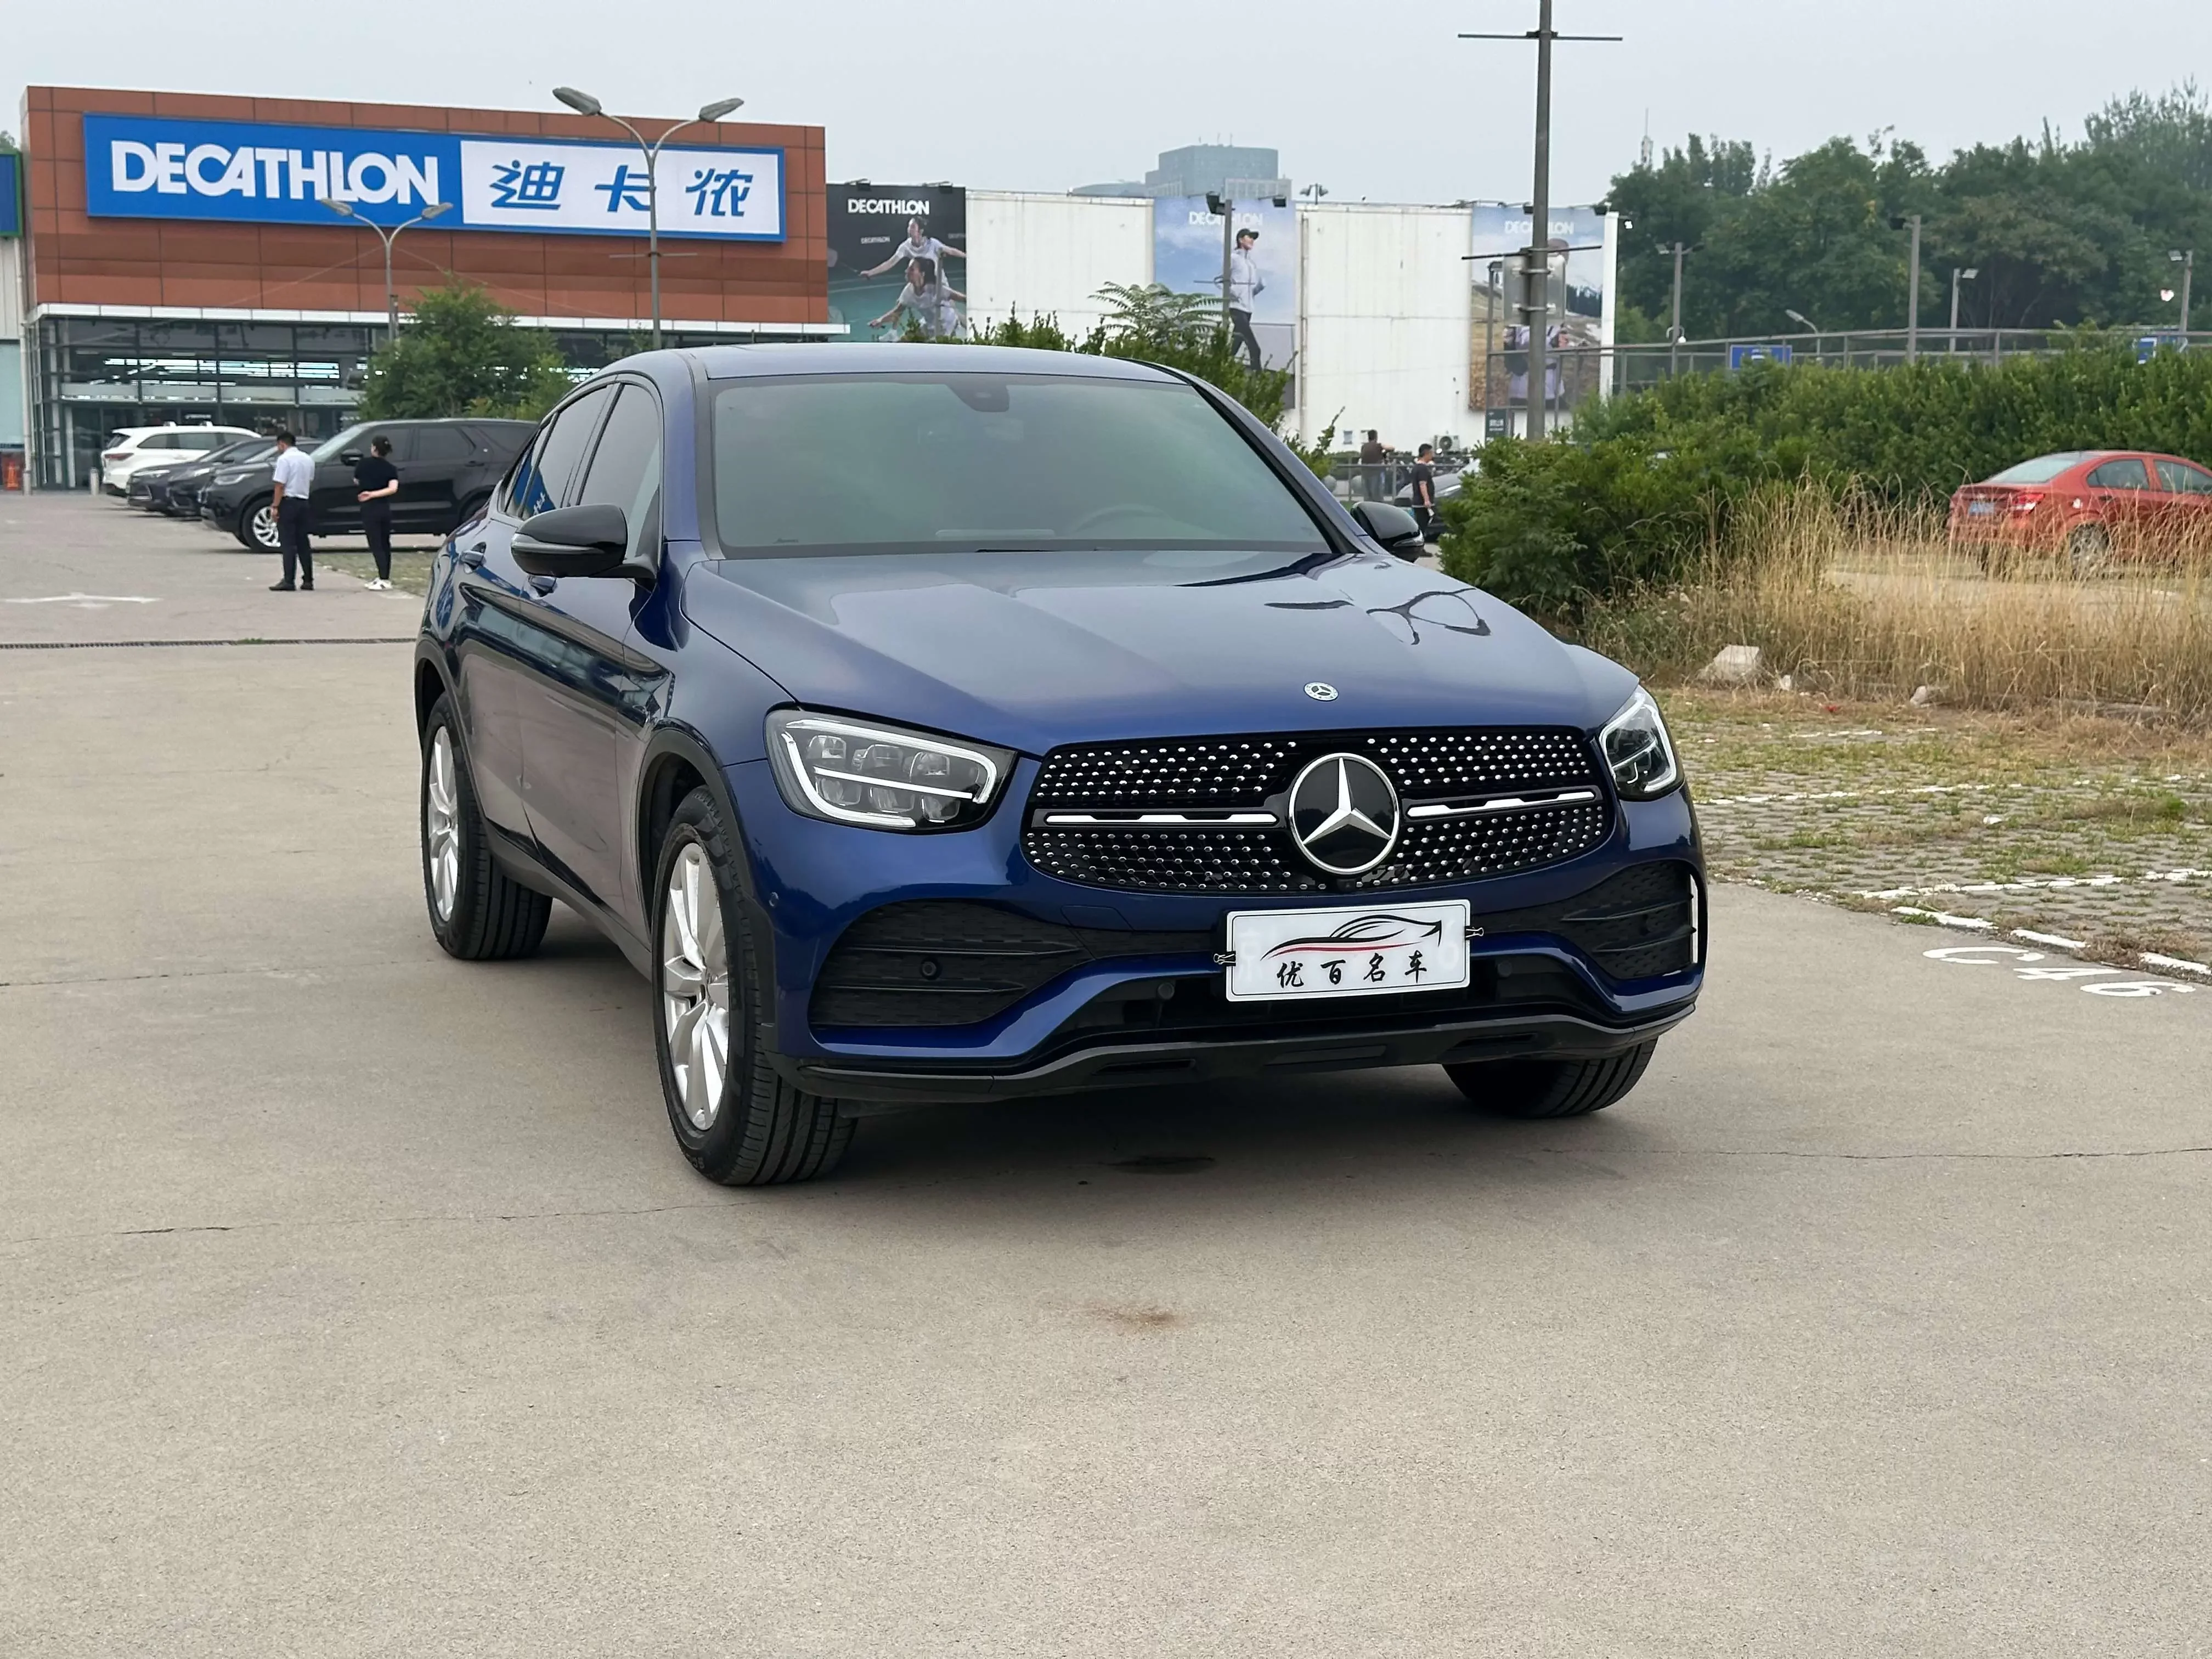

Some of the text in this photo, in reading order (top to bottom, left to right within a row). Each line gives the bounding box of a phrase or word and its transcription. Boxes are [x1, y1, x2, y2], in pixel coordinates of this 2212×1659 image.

[111, 140, 439, 206] DECATHLON
[490, 160, 753, 216] 迪卡侬
[848, 198, 930, 215] DECATHLON
[1505, 220, 1575, 234] DECLON
[1277, 950, 1427, 988] 优百名车
